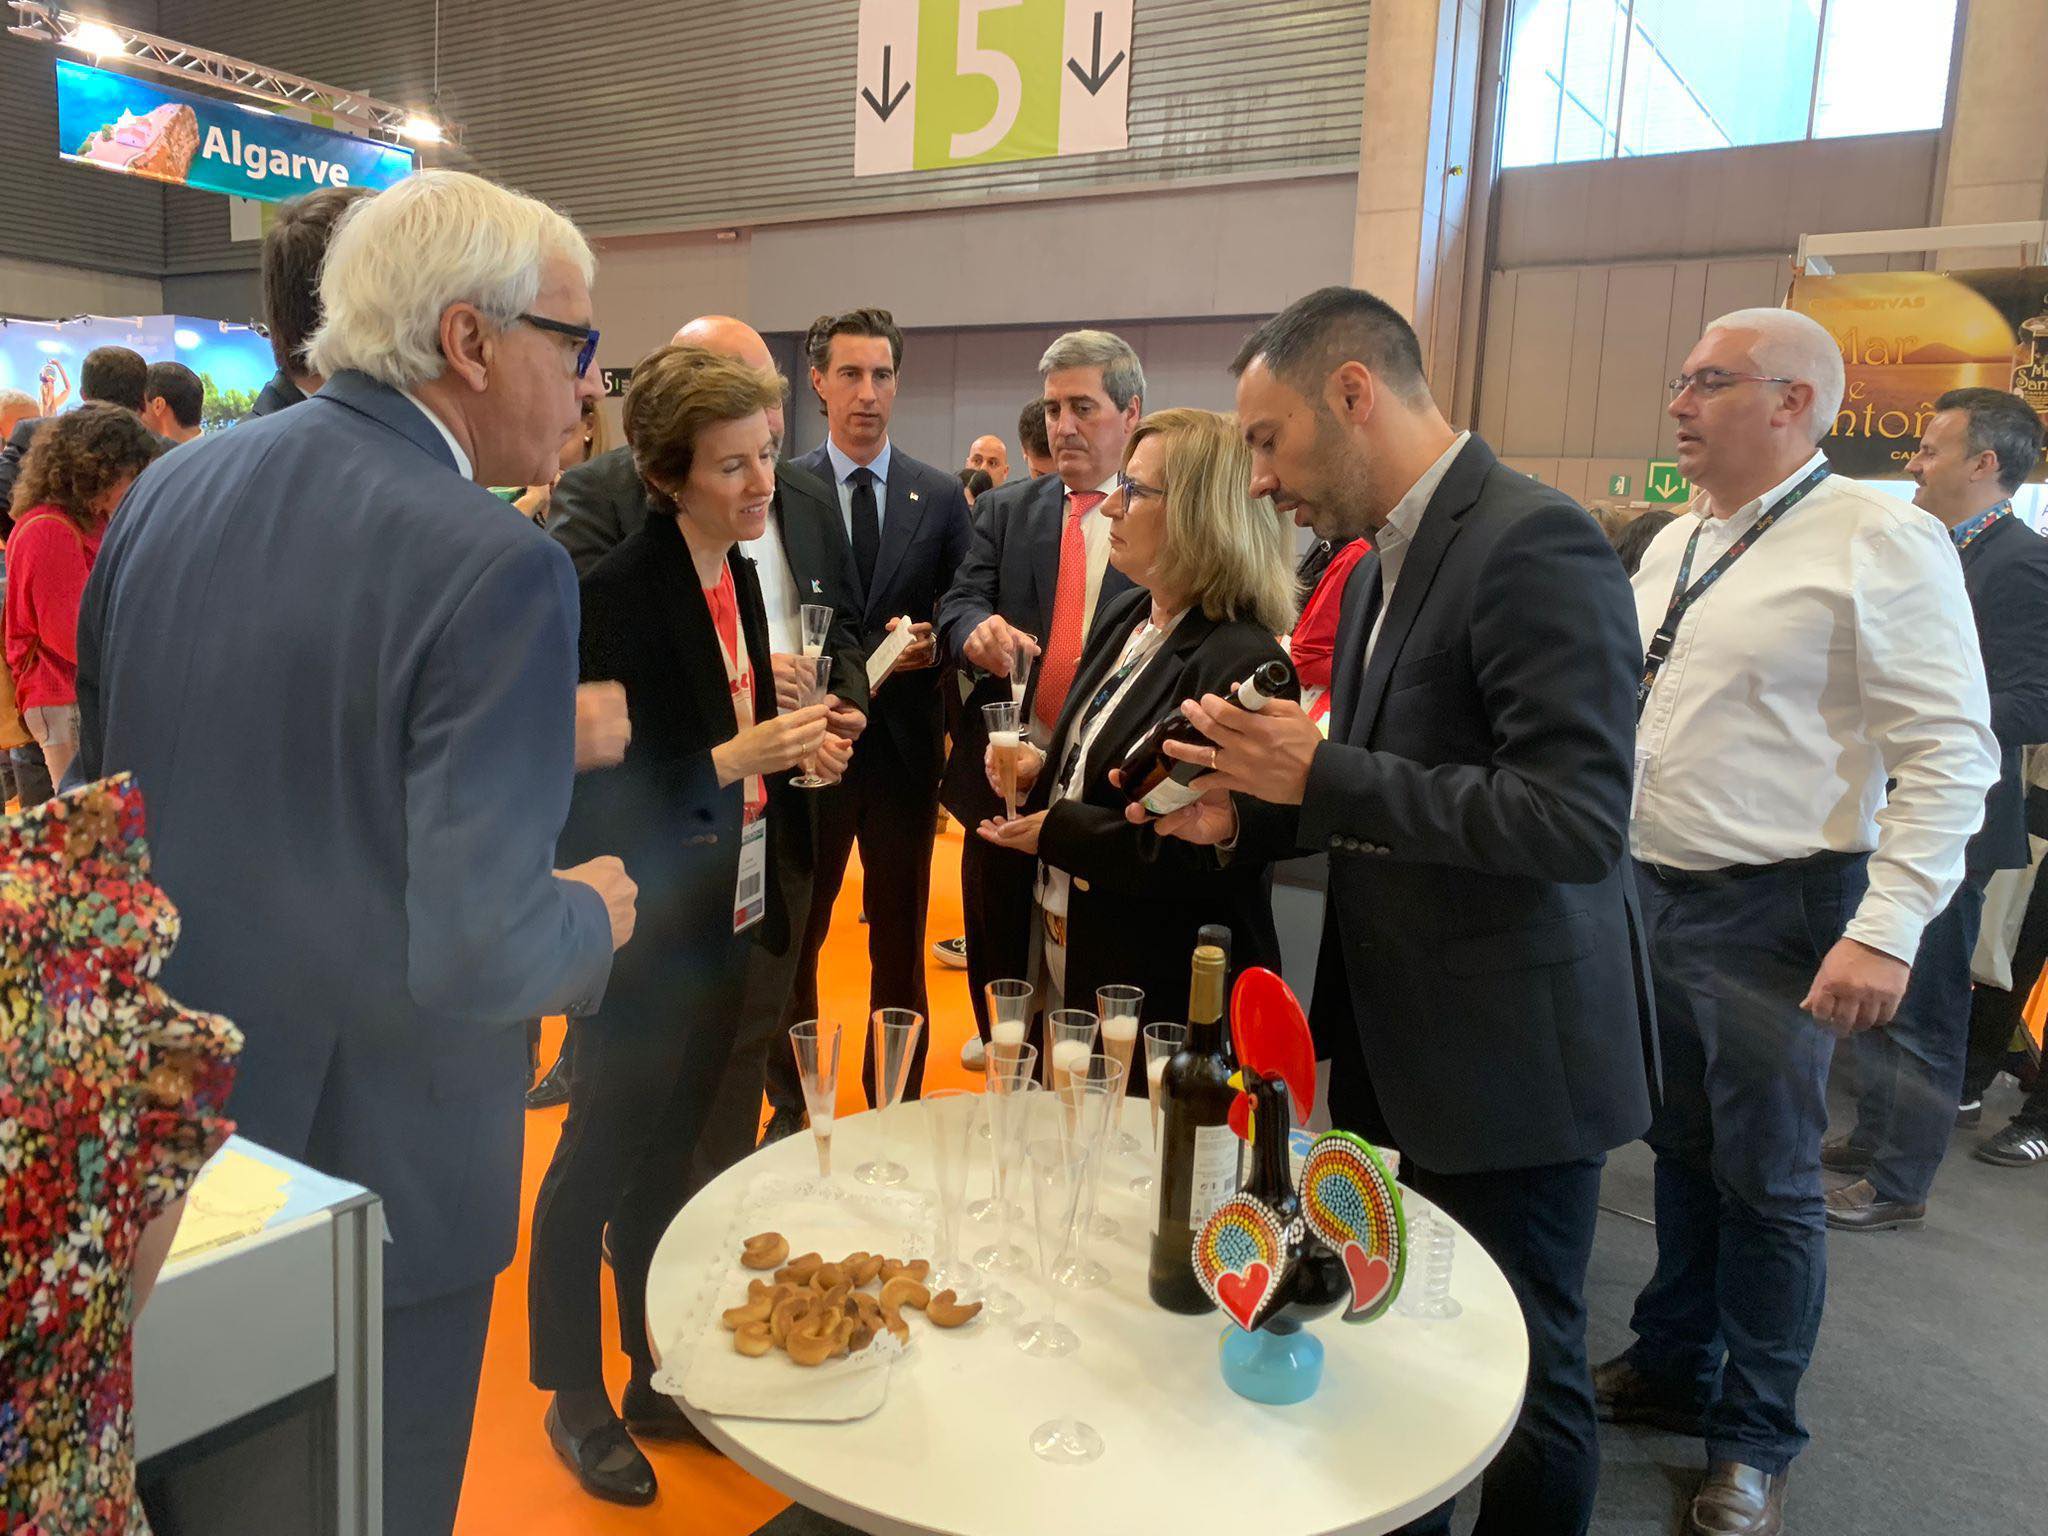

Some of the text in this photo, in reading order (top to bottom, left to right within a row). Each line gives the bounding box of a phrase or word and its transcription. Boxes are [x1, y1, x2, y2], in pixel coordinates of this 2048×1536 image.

[949, 0, 1022, 159] 5
[202, 126, 349, 187] Algarve
[604, 371, 613, 393] 5
